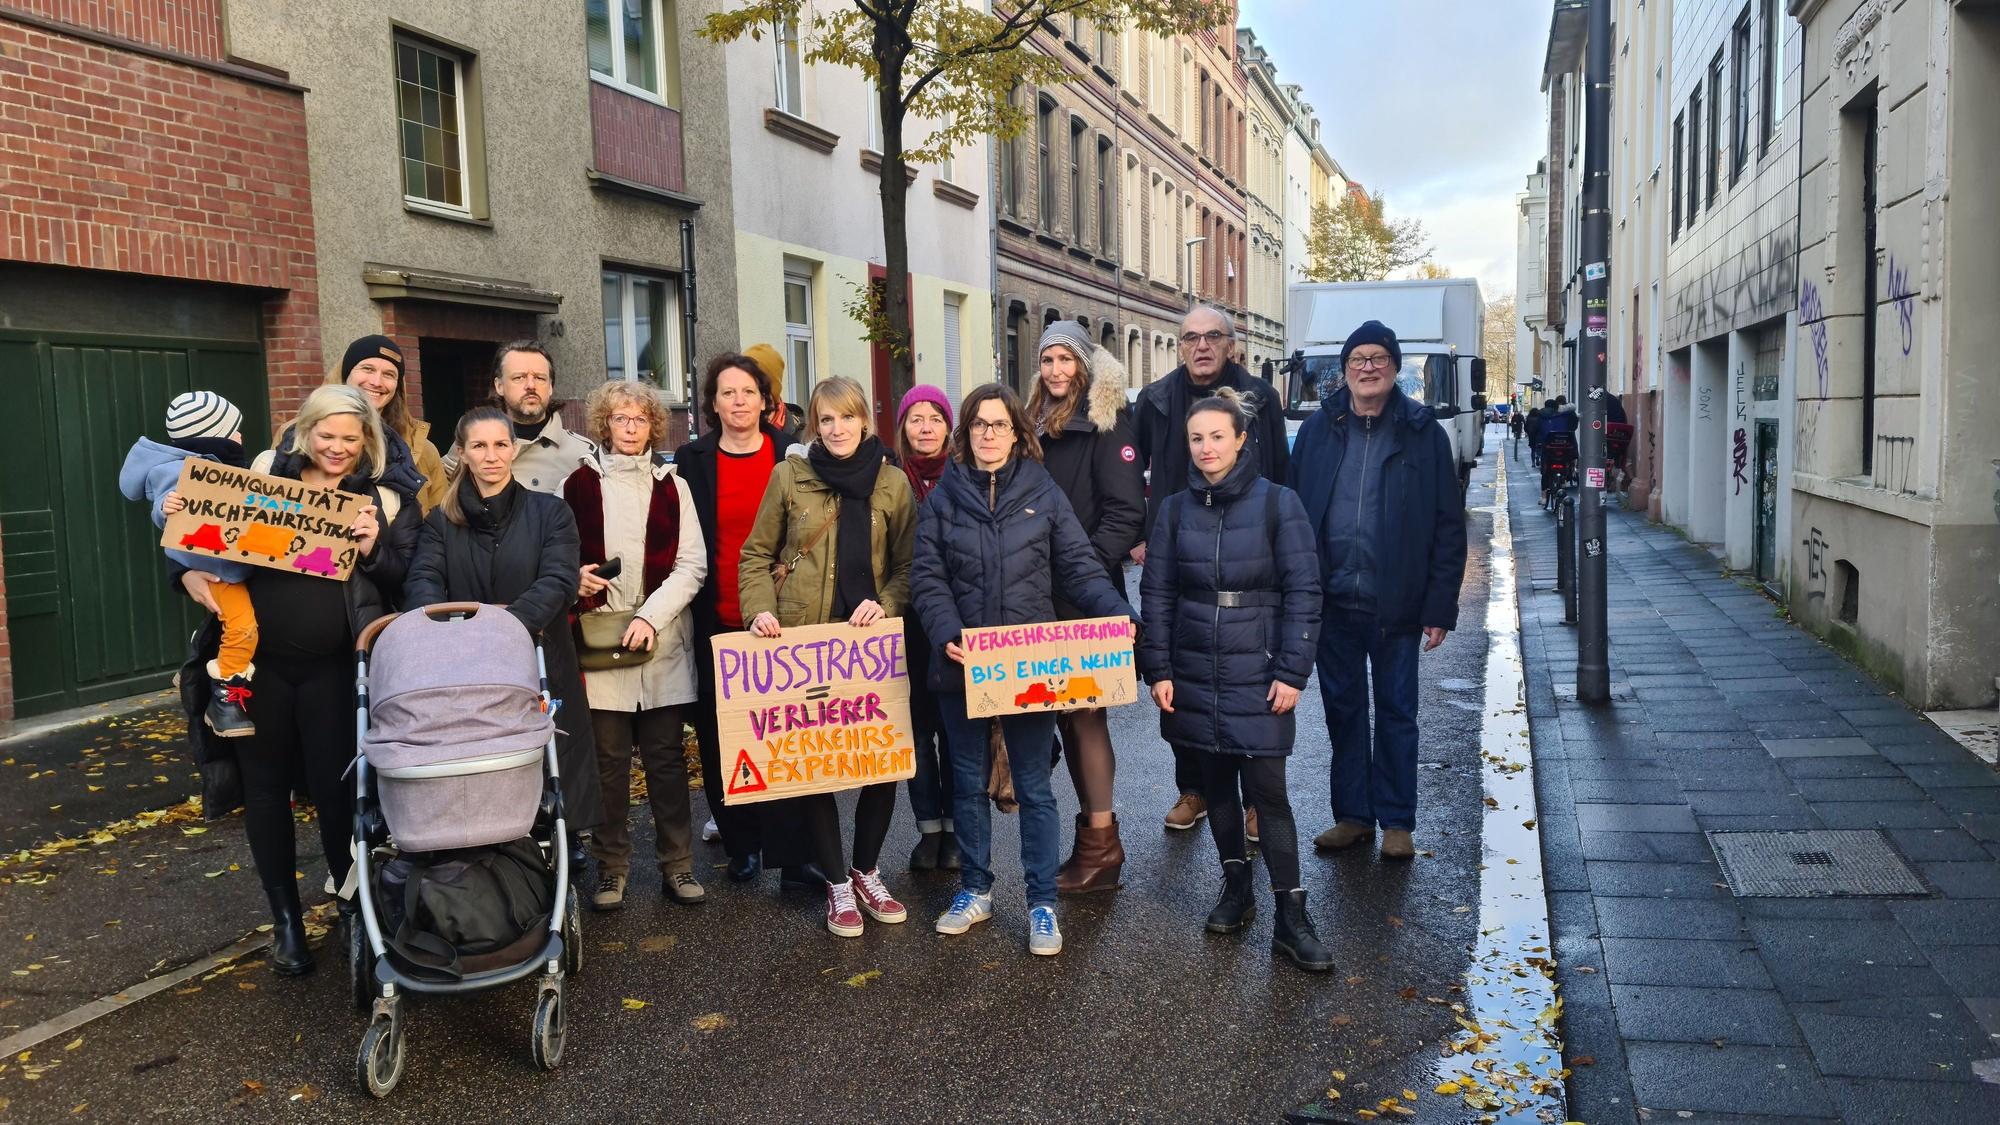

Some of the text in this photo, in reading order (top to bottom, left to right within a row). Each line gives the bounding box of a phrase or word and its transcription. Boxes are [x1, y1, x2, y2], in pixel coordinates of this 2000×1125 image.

[190, 465, 353, 512] WOHNQUALITÄT
[243, 494, 304, 512] STATT
[719, 633, 908, 699] PIUSSTRASSE
[971, 650, 1133, 685] BIS EINER WEINT
[749, 692, 888, 741] VERLIERER
[765, 724, 904, 759] VERKEHRS-
[767, 747, 913, 783] EXPERIMENT
